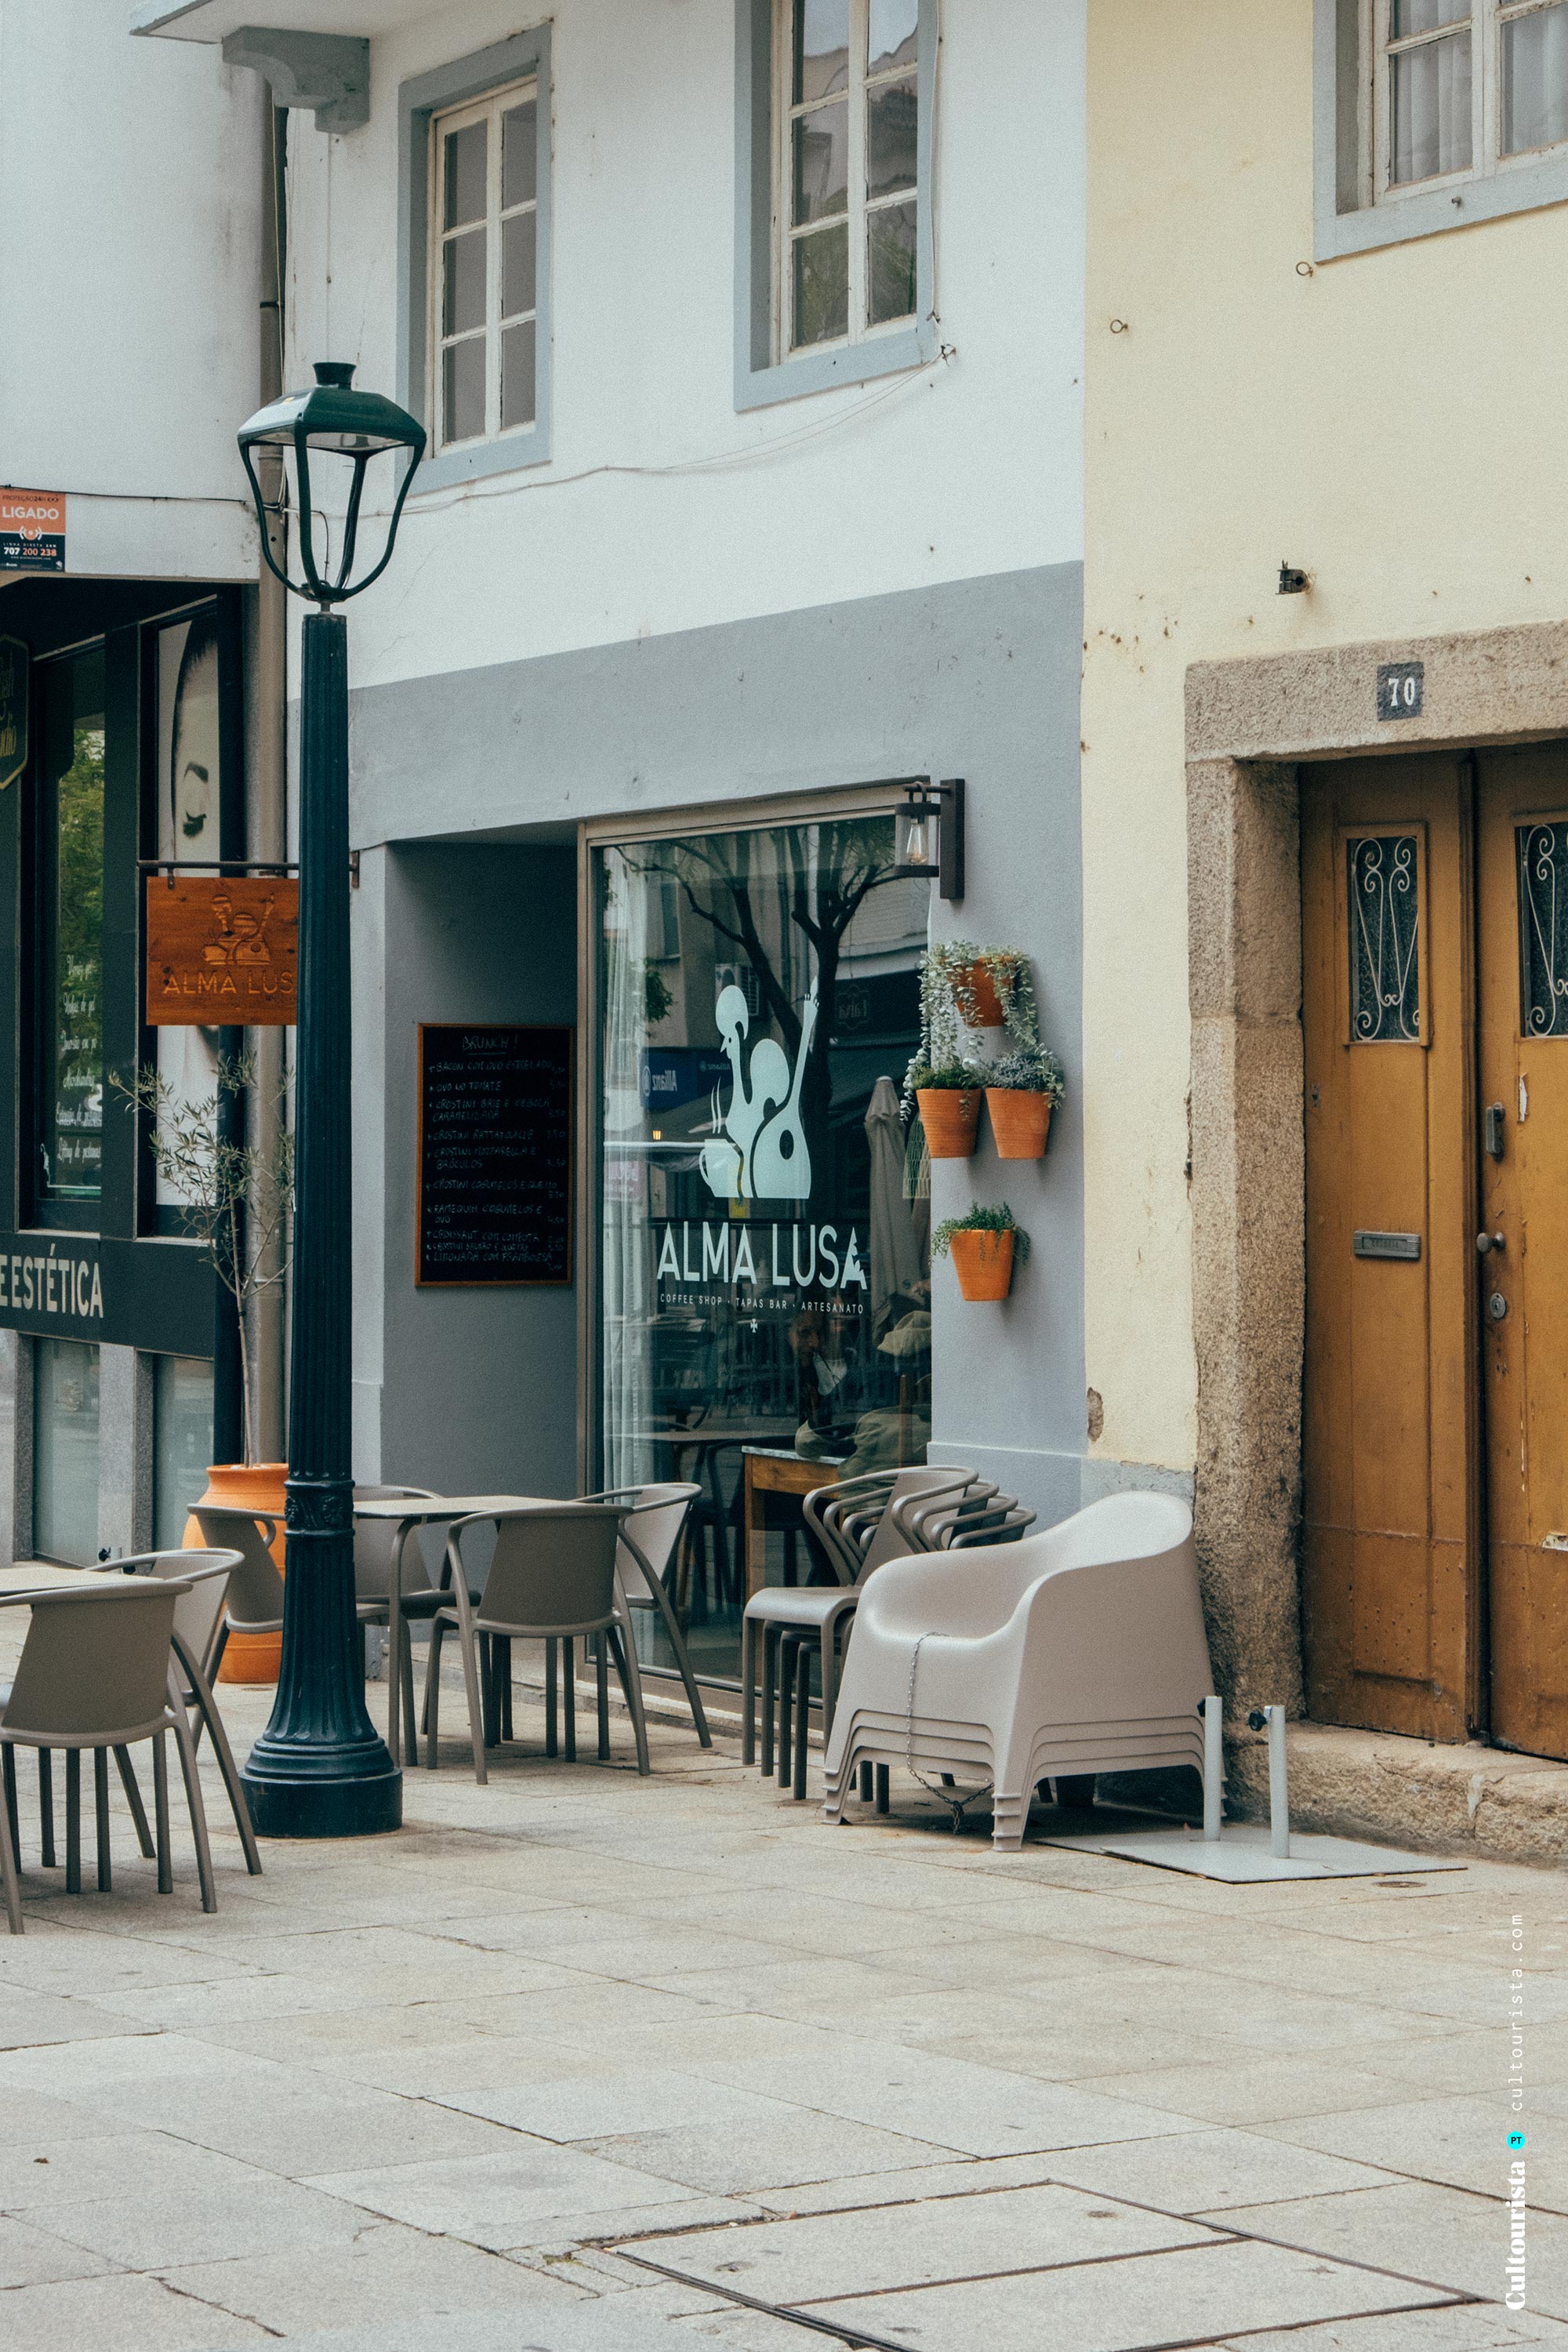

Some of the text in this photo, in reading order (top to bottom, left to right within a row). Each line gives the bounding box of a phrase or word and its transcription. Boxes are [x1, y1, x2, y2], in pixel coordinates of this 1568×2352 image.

[2, 506, 60, 520] LIGADO
[3, 546, 57, 557] 707 200 238
[1388, 677, 1416, 706] 70
[162, 970, 294, 994] ALMA LUS
[657, 1221, 868, 1290] ALMA LUSA
[11, 1243, 104, 1319] ESTÉTICA
[660, 1294, 863, 1314] COFFEE SHOP TAPAS BAR ARTESANATO
